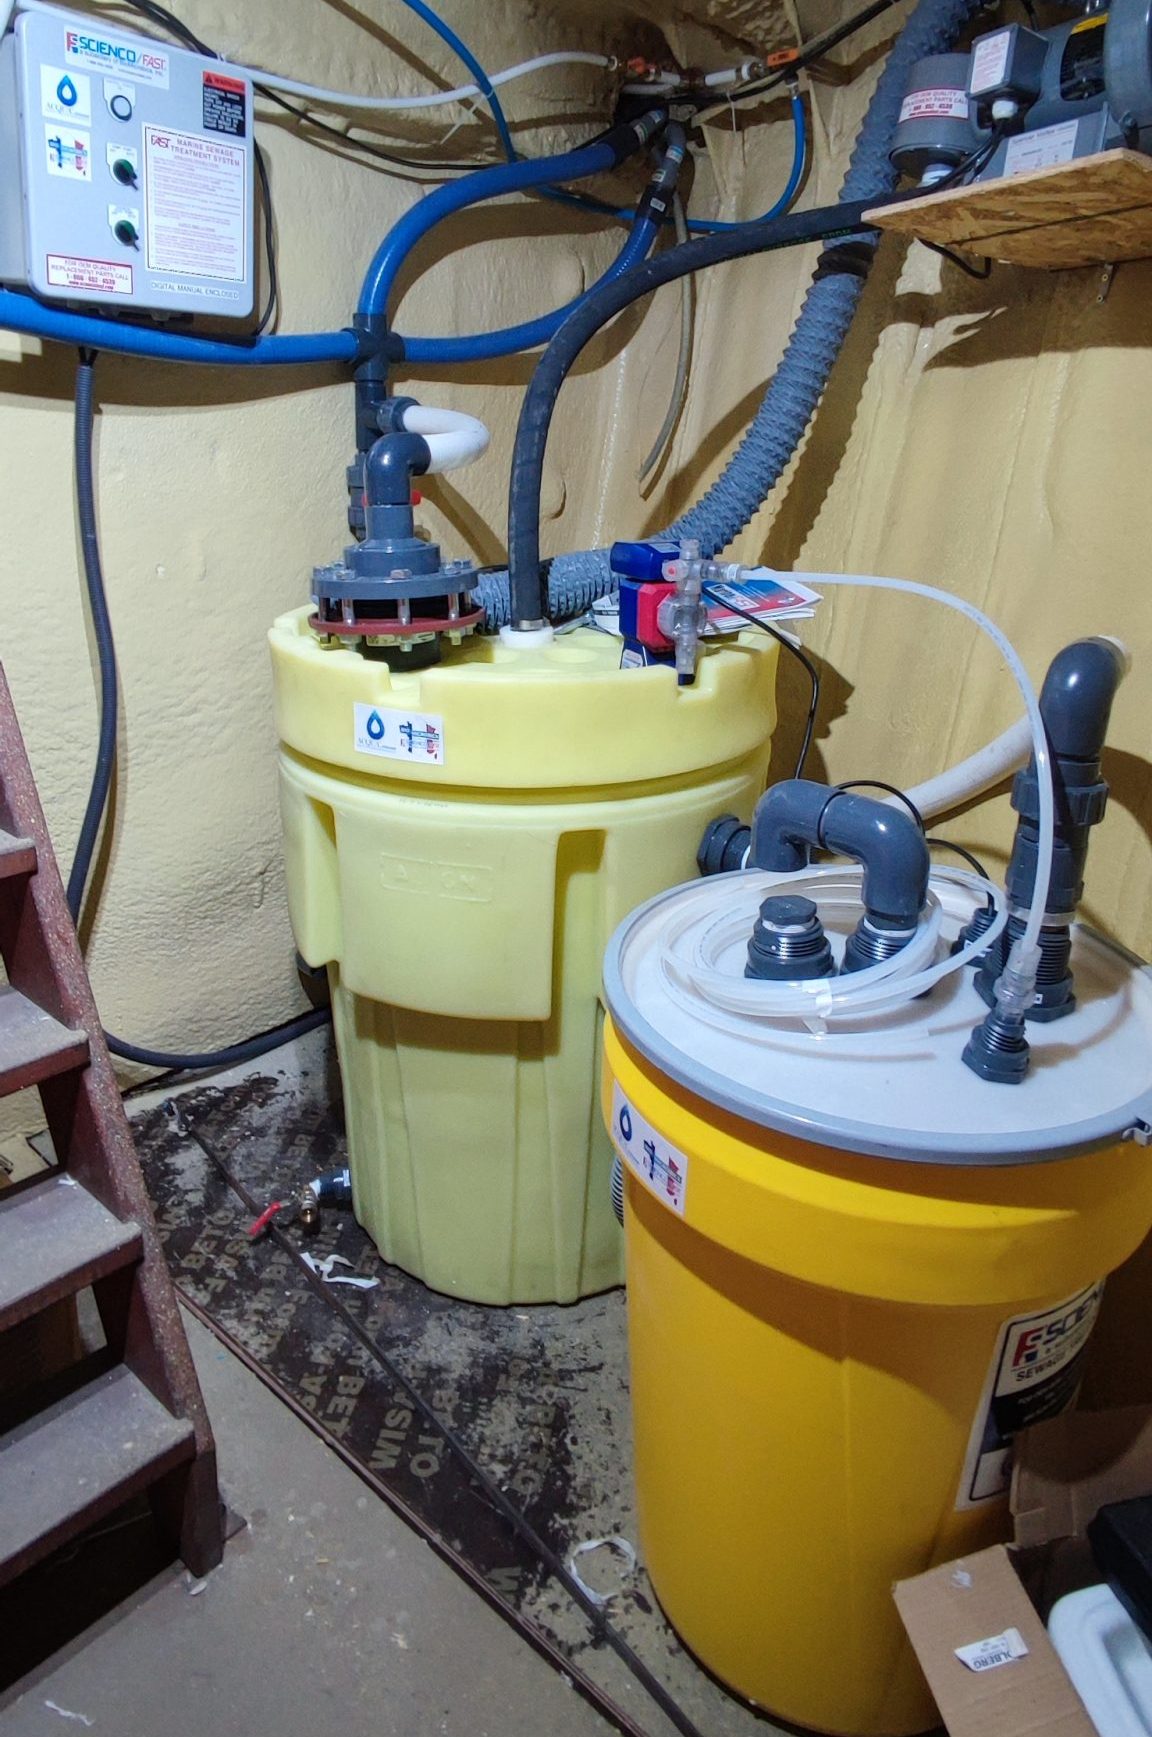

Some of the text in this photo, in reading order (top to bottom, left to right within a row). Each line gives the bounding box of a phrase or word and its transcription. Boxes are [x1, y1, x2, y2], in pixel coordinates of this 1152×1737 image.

[171, 145, 240, 167] TREATMENT SYSTEM
[176, 138, 203, 151] MARINE
[206, 145, 234, 158] SEWAGE
[51, 264, 94, 275] REPLACEMENT
[95, 270, 114, 278] PARTS
[151, 281, 240, 299] DIGITAL MANUAL ENCLOSED
